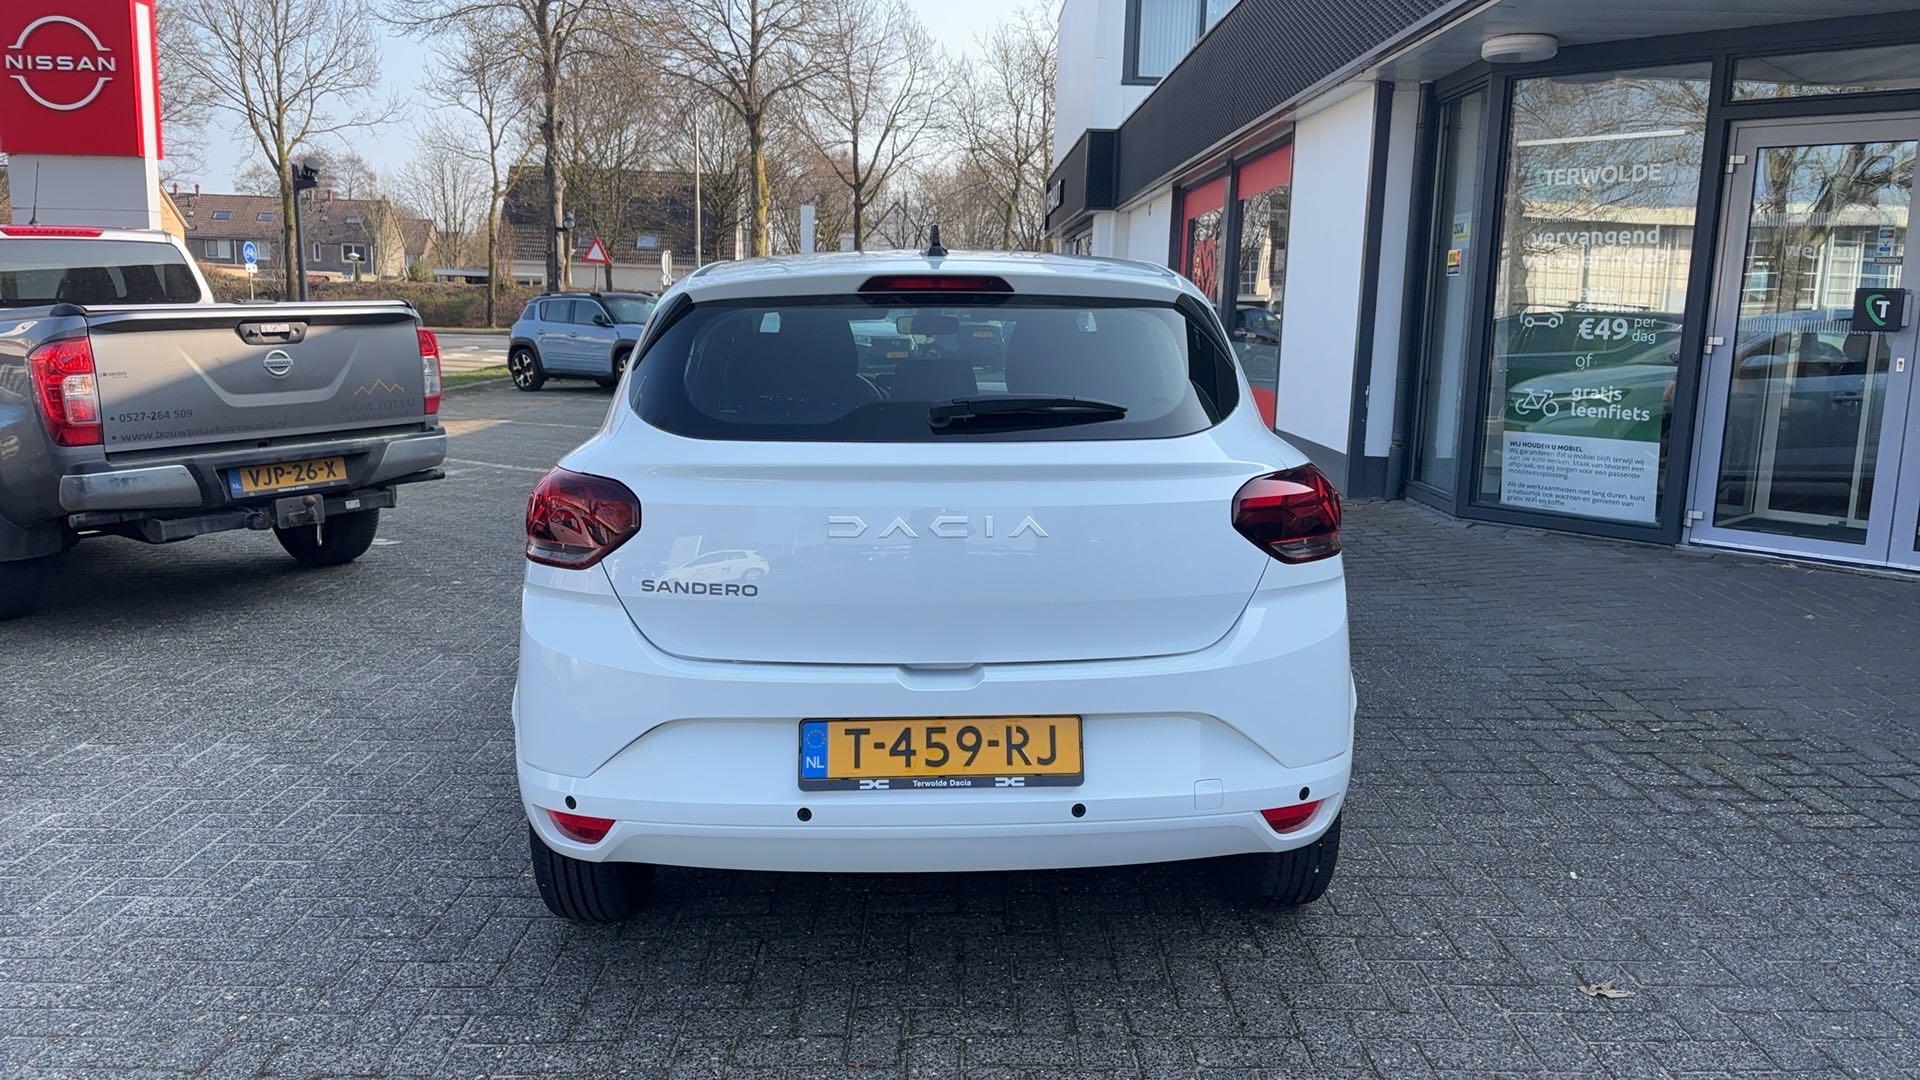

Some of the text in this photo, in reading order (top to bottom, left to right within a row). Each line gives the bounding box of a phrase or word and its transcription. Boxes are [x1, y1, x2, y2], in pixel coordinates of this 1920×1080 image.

[5, 54, 117, 72] NISSAN
[1542, 163, 1663, 187] TERWOLDE
[1530, 223, 1661, 246] vervangend
[1876, 300, 1891, 319] T
[1578, 317, 1629, 341] €49
[1633, 317, 1657, 329] per
[1631, 330, 1657, 344] dag
[1575, 353, 1594, 367] of
[1571, 386, 1623, 401] gratis
[119, 409, 193, 423] 0527-264 509
[1570, 404, 1651, 422] leenfiets
[1522, 442, 1550, 450] HOUDEN
[247, 460, 337, 488] VJP-26-X
[827, 515, 1049, 539] DACIA
[641, 579, 759, 598] SANDERO
[844, 725, 1057, 769] T-459-RJ
[805, 756, 825, 769] NL
[912, 778, 972, 789] Terwolde Dacia
